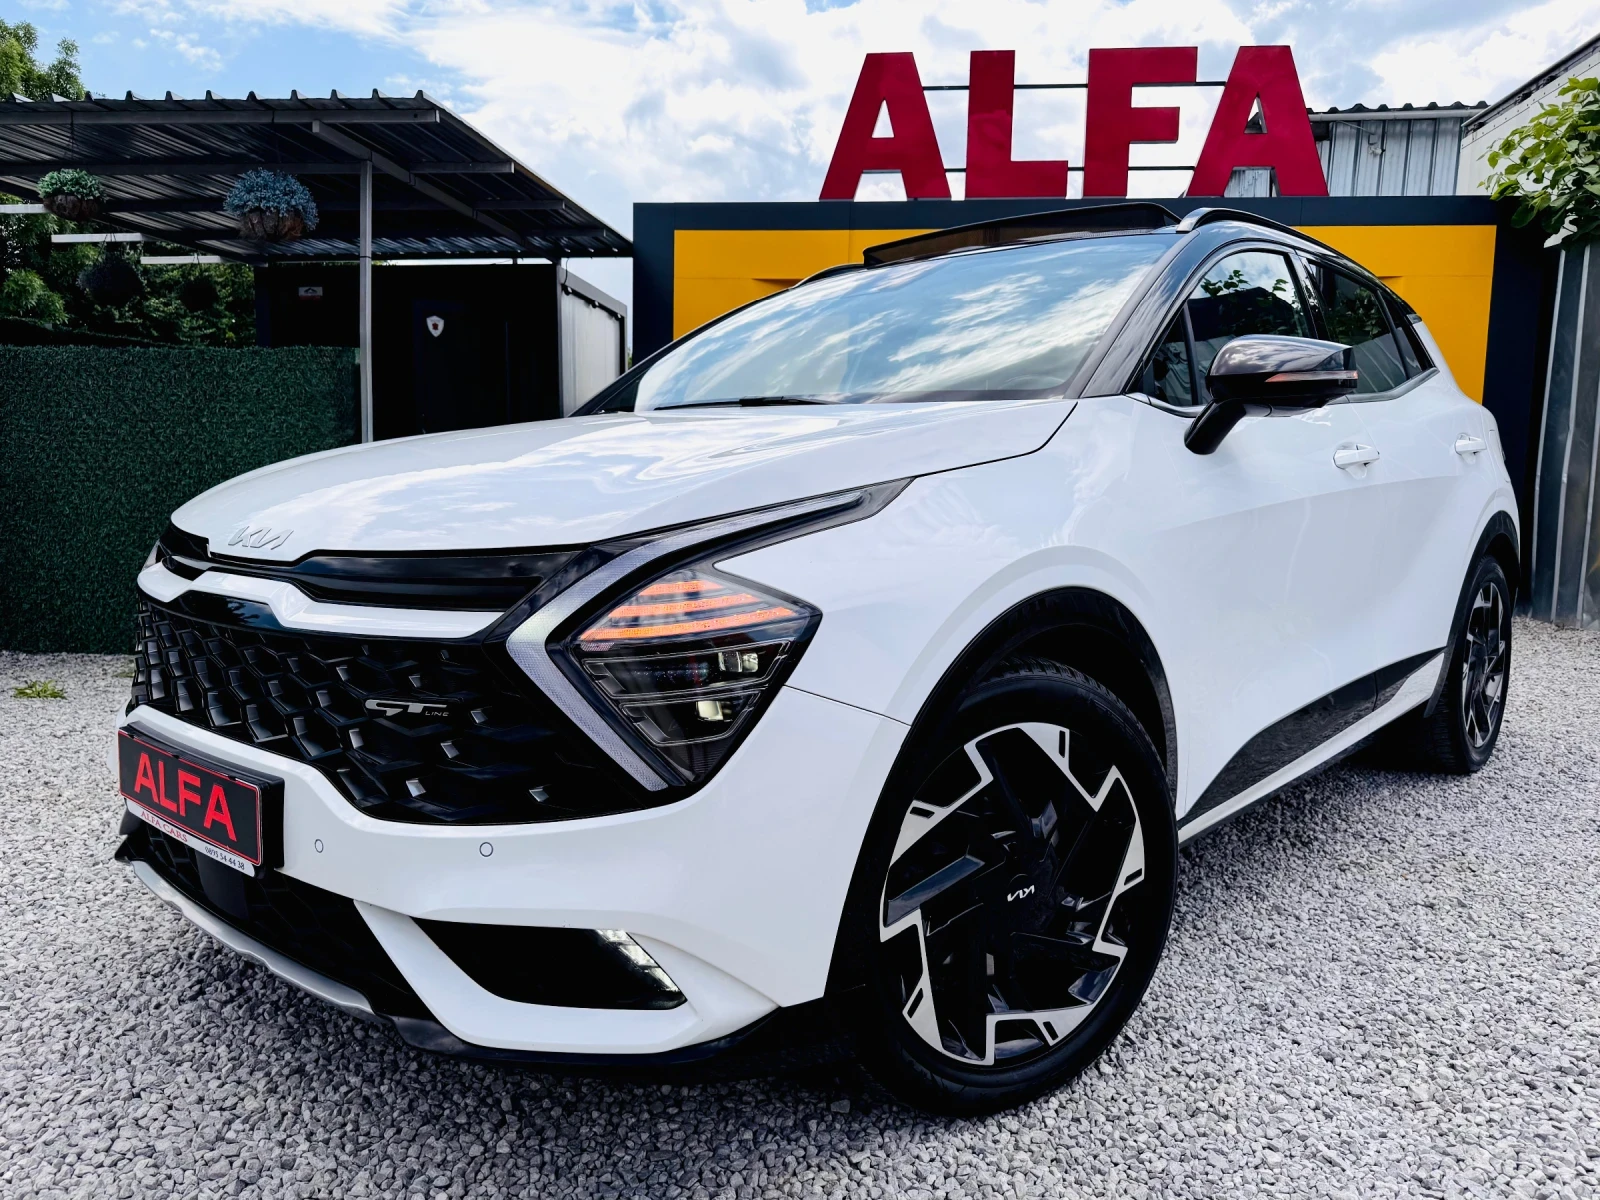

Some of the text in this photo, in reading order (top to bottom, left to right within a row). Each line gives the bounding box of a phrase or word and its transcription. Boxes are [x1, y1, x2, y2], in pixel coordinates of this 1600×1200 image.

[819, 45, 1330, 200] ALFA
[365, 699, 447, 716] GT
[134, 752, 237, 842] ALFA
[141, 810, 188, 842] ALFA CARS
